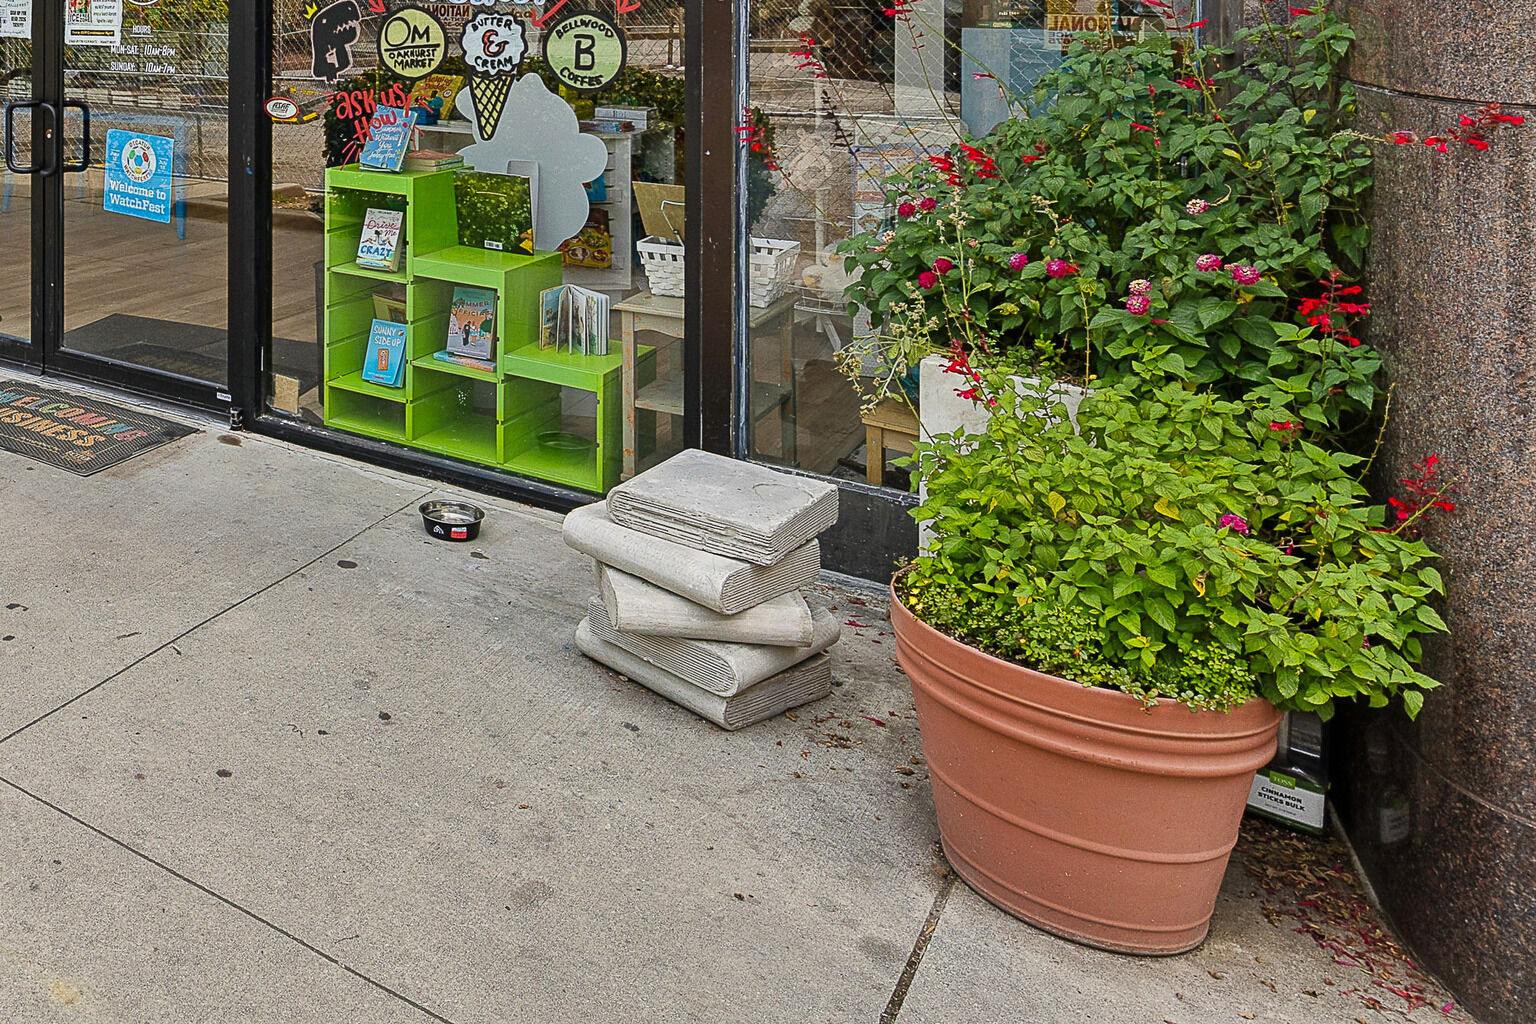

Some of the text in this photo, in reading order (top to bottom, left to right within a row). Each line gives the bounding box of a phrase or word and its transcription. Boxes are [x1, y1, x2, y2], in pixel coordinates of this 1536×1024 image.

[132, 25, 152, 34] HOURS
[471, 16, 513, 33] BUTTER
[555, 18, 614, 40] BELLWOOD
[481, 29, 510, 57] &
[388, 48, 437, 60] OAKHURST
[573, 33, 596, 71] B
[393, 58, 435, 71] MARKET
[474, 55, 513, 70] CREAM
[336, 83, 405, 120] ask us
[128, 139, 151, 151] DECATUR
[109, 179, 167, 201] Welcome to
[109, 192, 166, 215] WatchFest
[366, 219, 397, 230] Drive
[360, 245, 393, 258] CRAZY
[374, 324, 397, 337] SUNNY
[374, 336, 402, 348] SIDE UP
[1257, 791, 1284, 805] STICKS
[1285, 800, 1306, 812] BULK
[1261, 786, 1303, 805] CINNAMON
